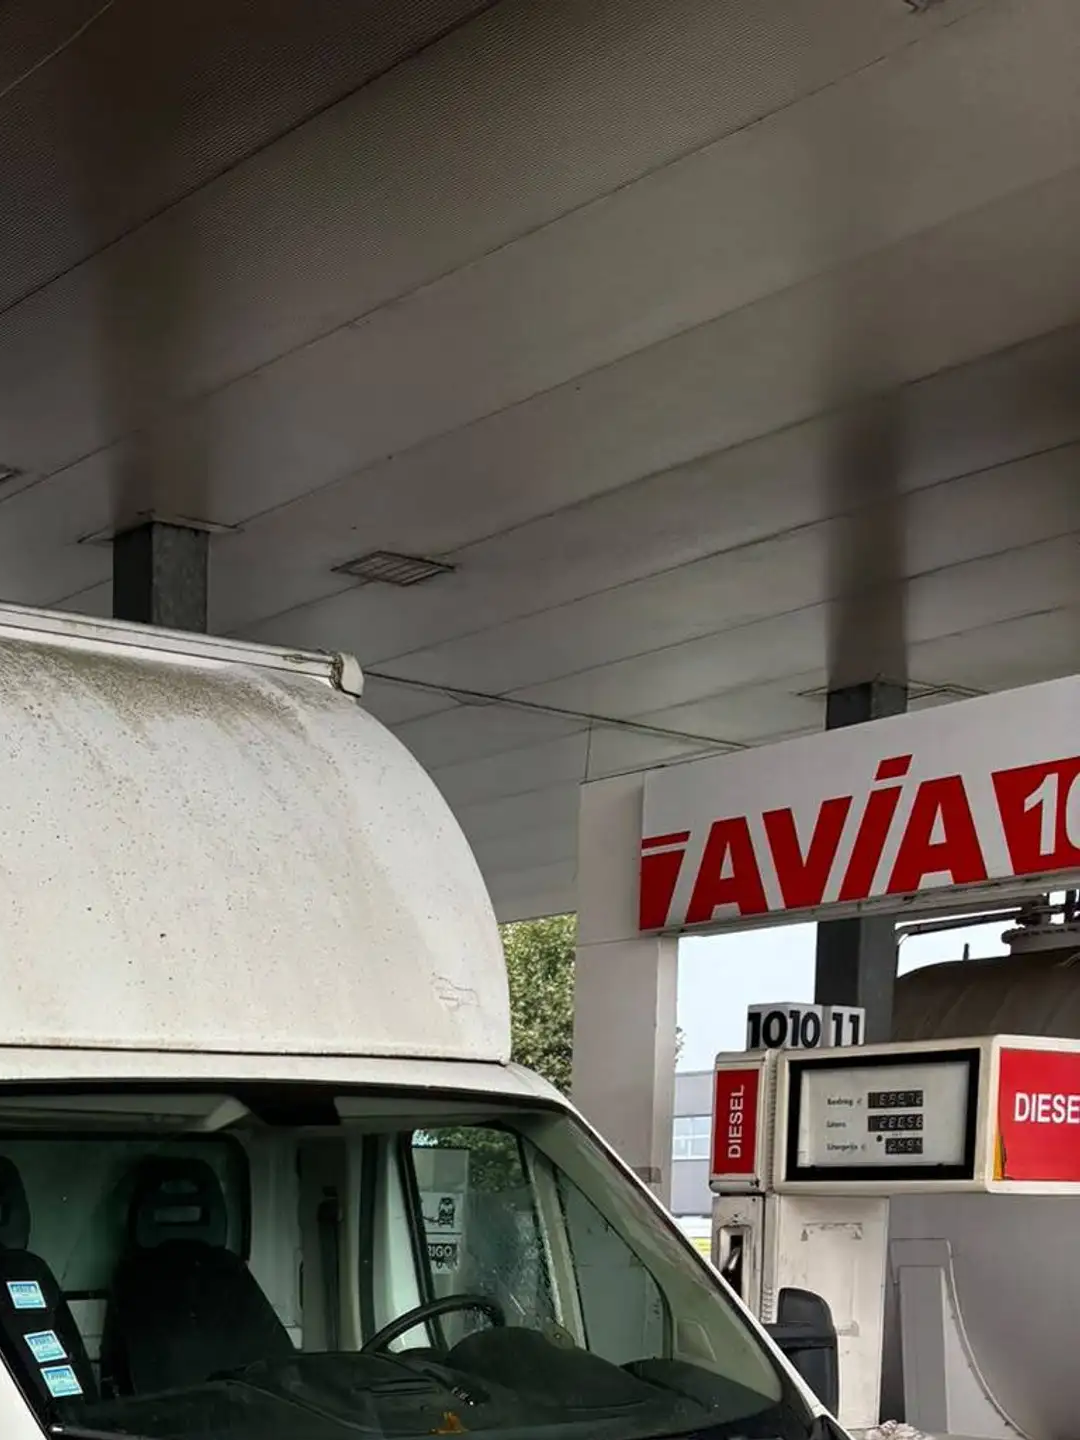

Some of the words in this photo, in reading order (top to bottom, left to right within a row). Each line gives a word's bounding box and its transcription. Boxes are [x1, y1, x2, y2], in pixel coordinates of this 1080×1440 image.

[748, 1011, 788, 1049] 10
[789, 1009, 821, 1049] 10
[832, 1012, 860, 1047] 11
[728, 1084, 745, 1158] DIESEL
[1014, 1092, 1080, 1124] DIESE
